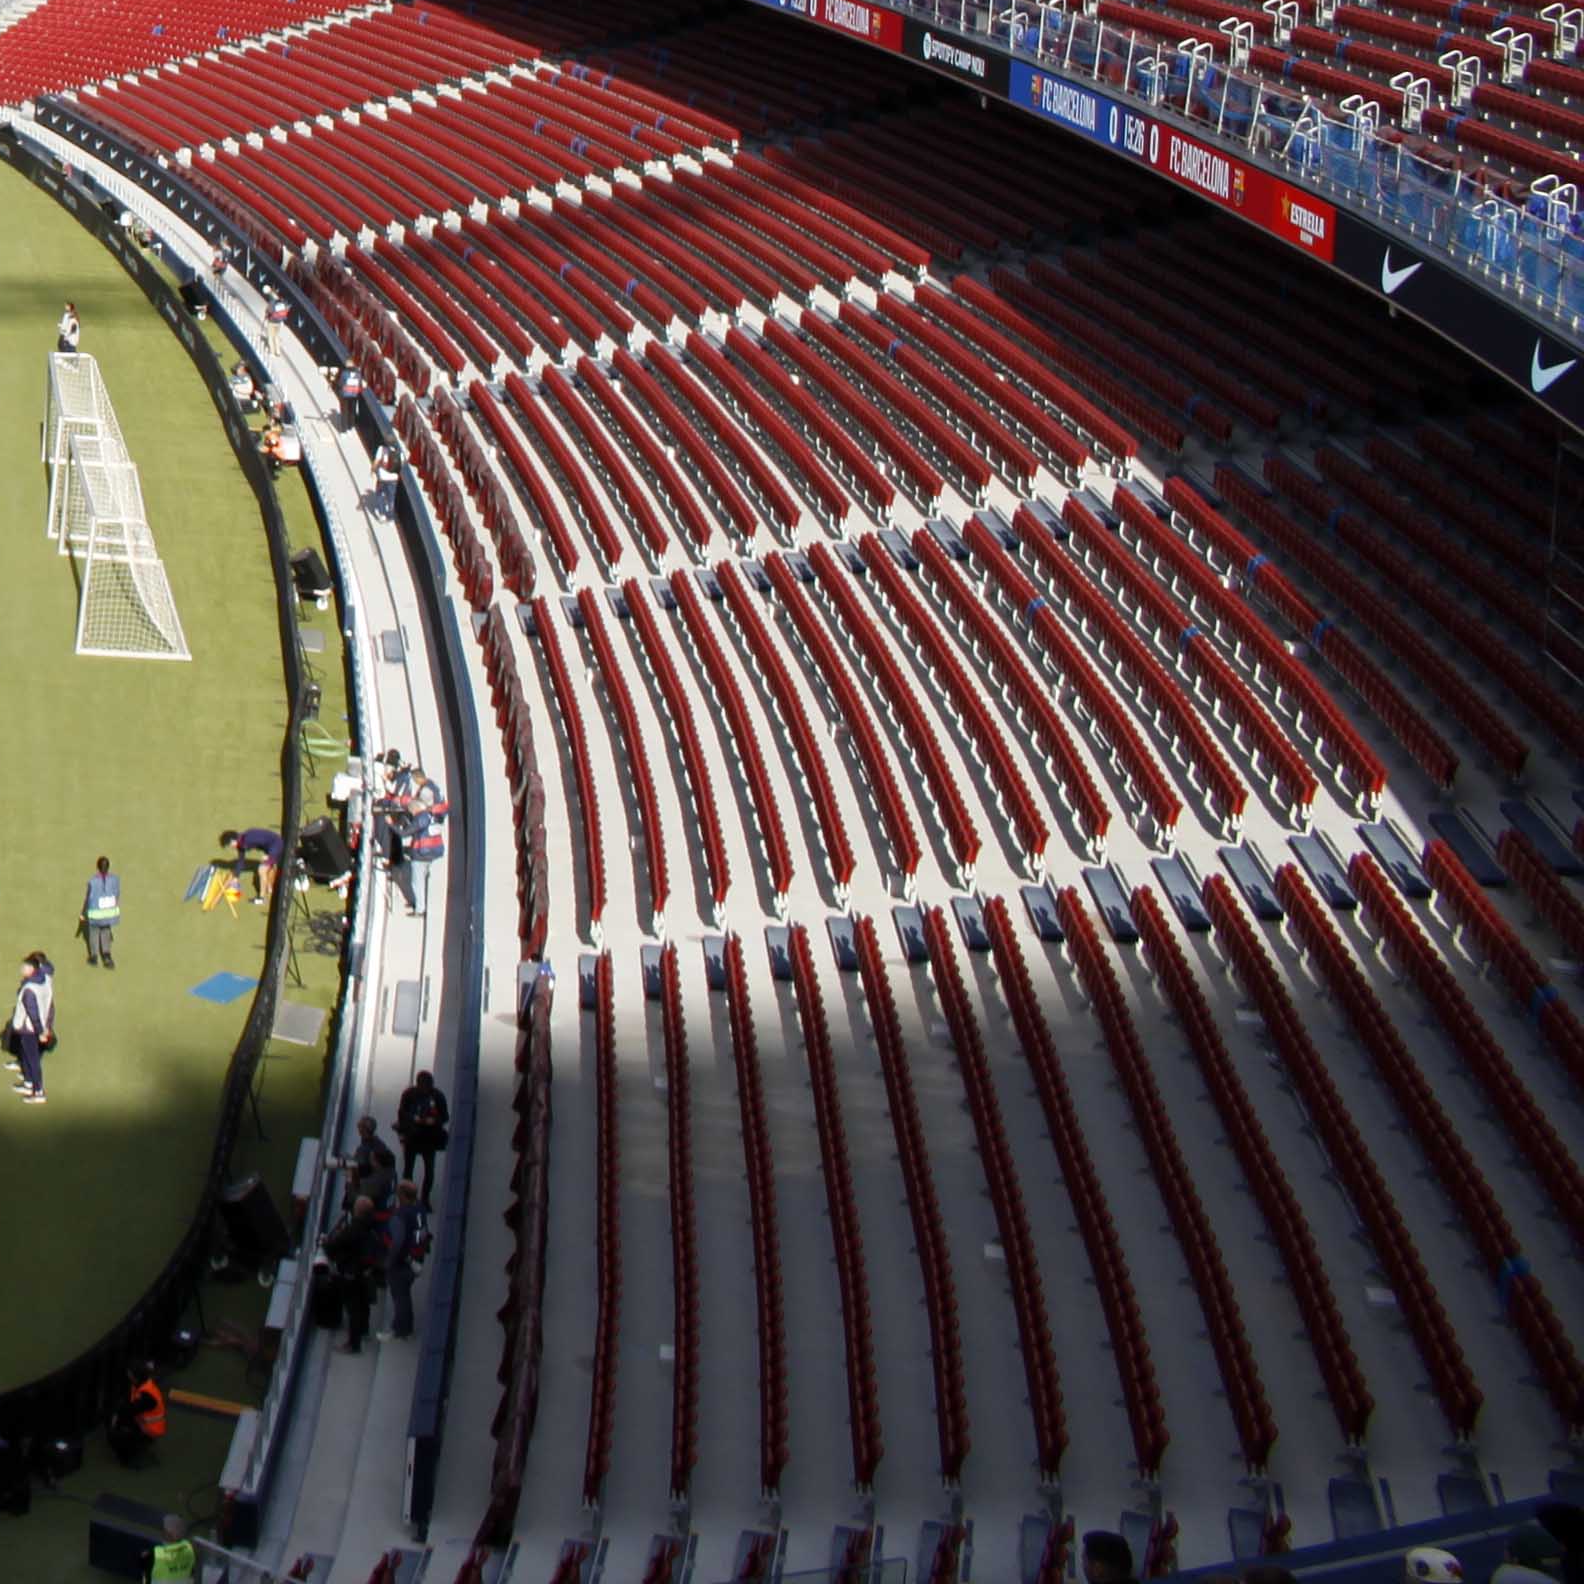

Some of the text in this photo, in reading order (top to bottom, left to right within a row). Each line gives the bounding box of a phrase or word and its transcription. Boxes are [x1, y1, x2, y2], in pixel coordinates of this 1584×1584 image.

[1042, 77, 1230, 200] FC BARCELONA 0 15:26 0 FC BARCELONA
[1291, 202, 1325, 240] ESTRELLA
